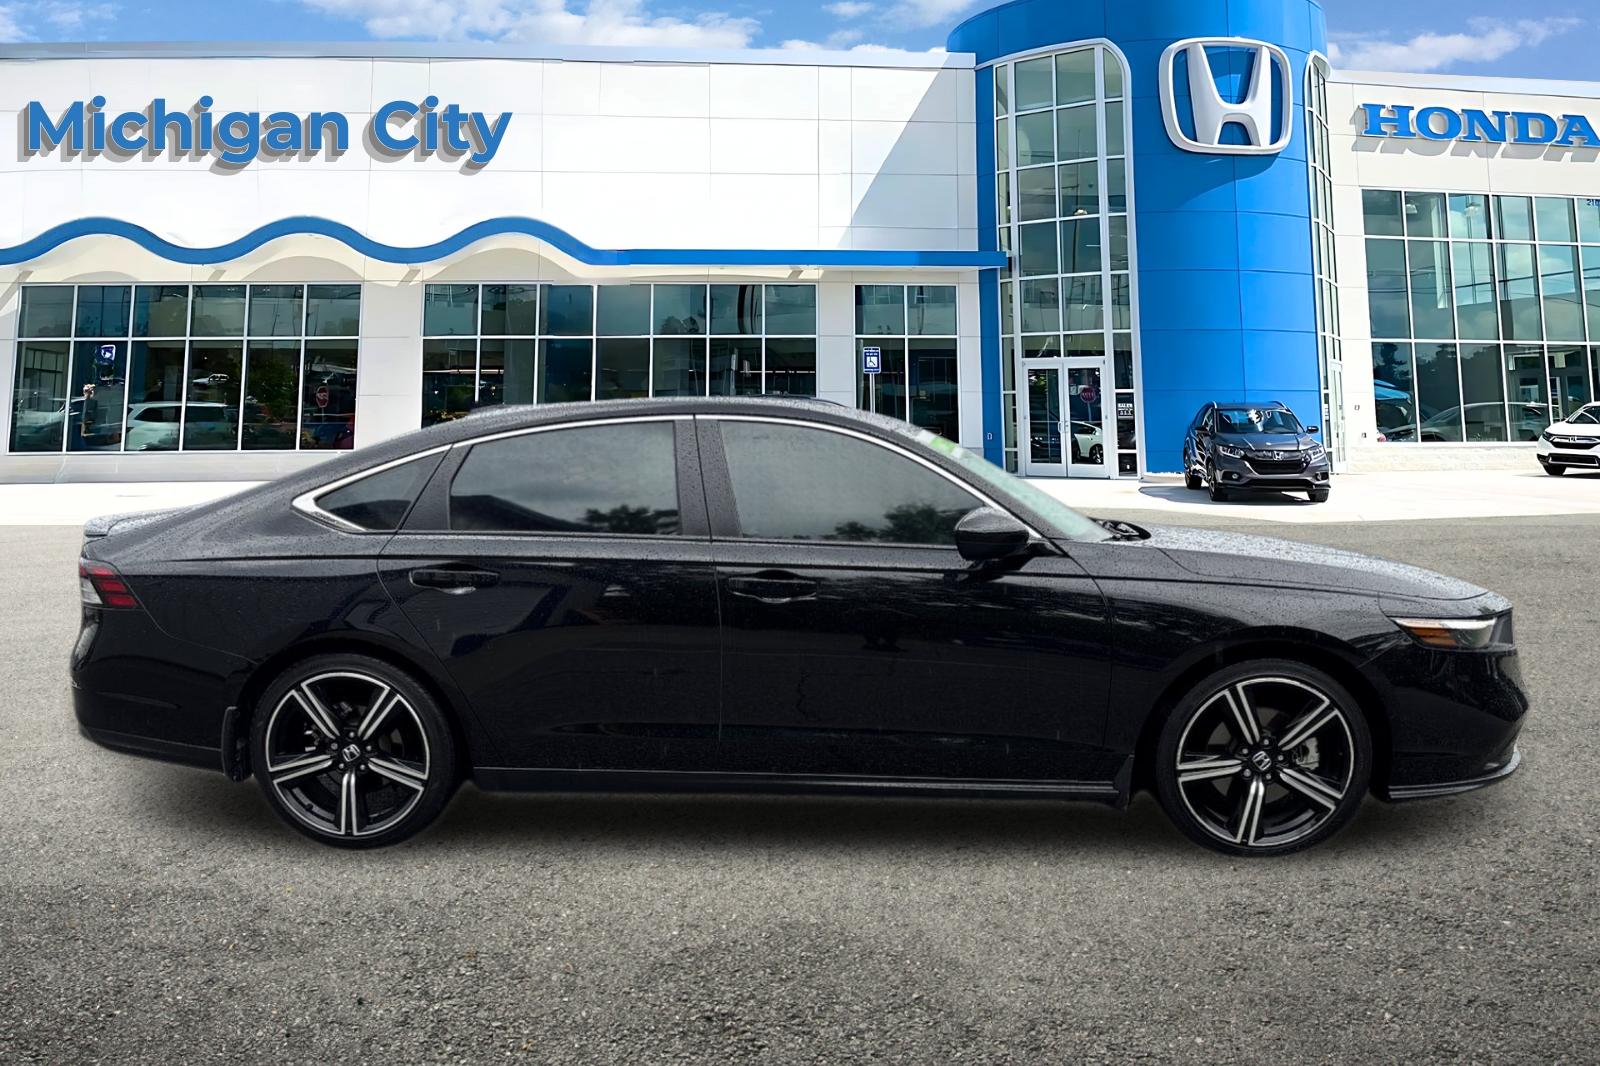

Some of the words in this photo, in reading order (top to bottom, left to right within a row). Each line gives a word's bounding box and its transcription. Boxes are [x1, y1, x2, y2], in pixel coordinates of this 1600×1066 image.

[27, 95, 349, 163] Michigan
[370, 95, 513, 163] City
[1361, 103, 1600, 147] HONDA
